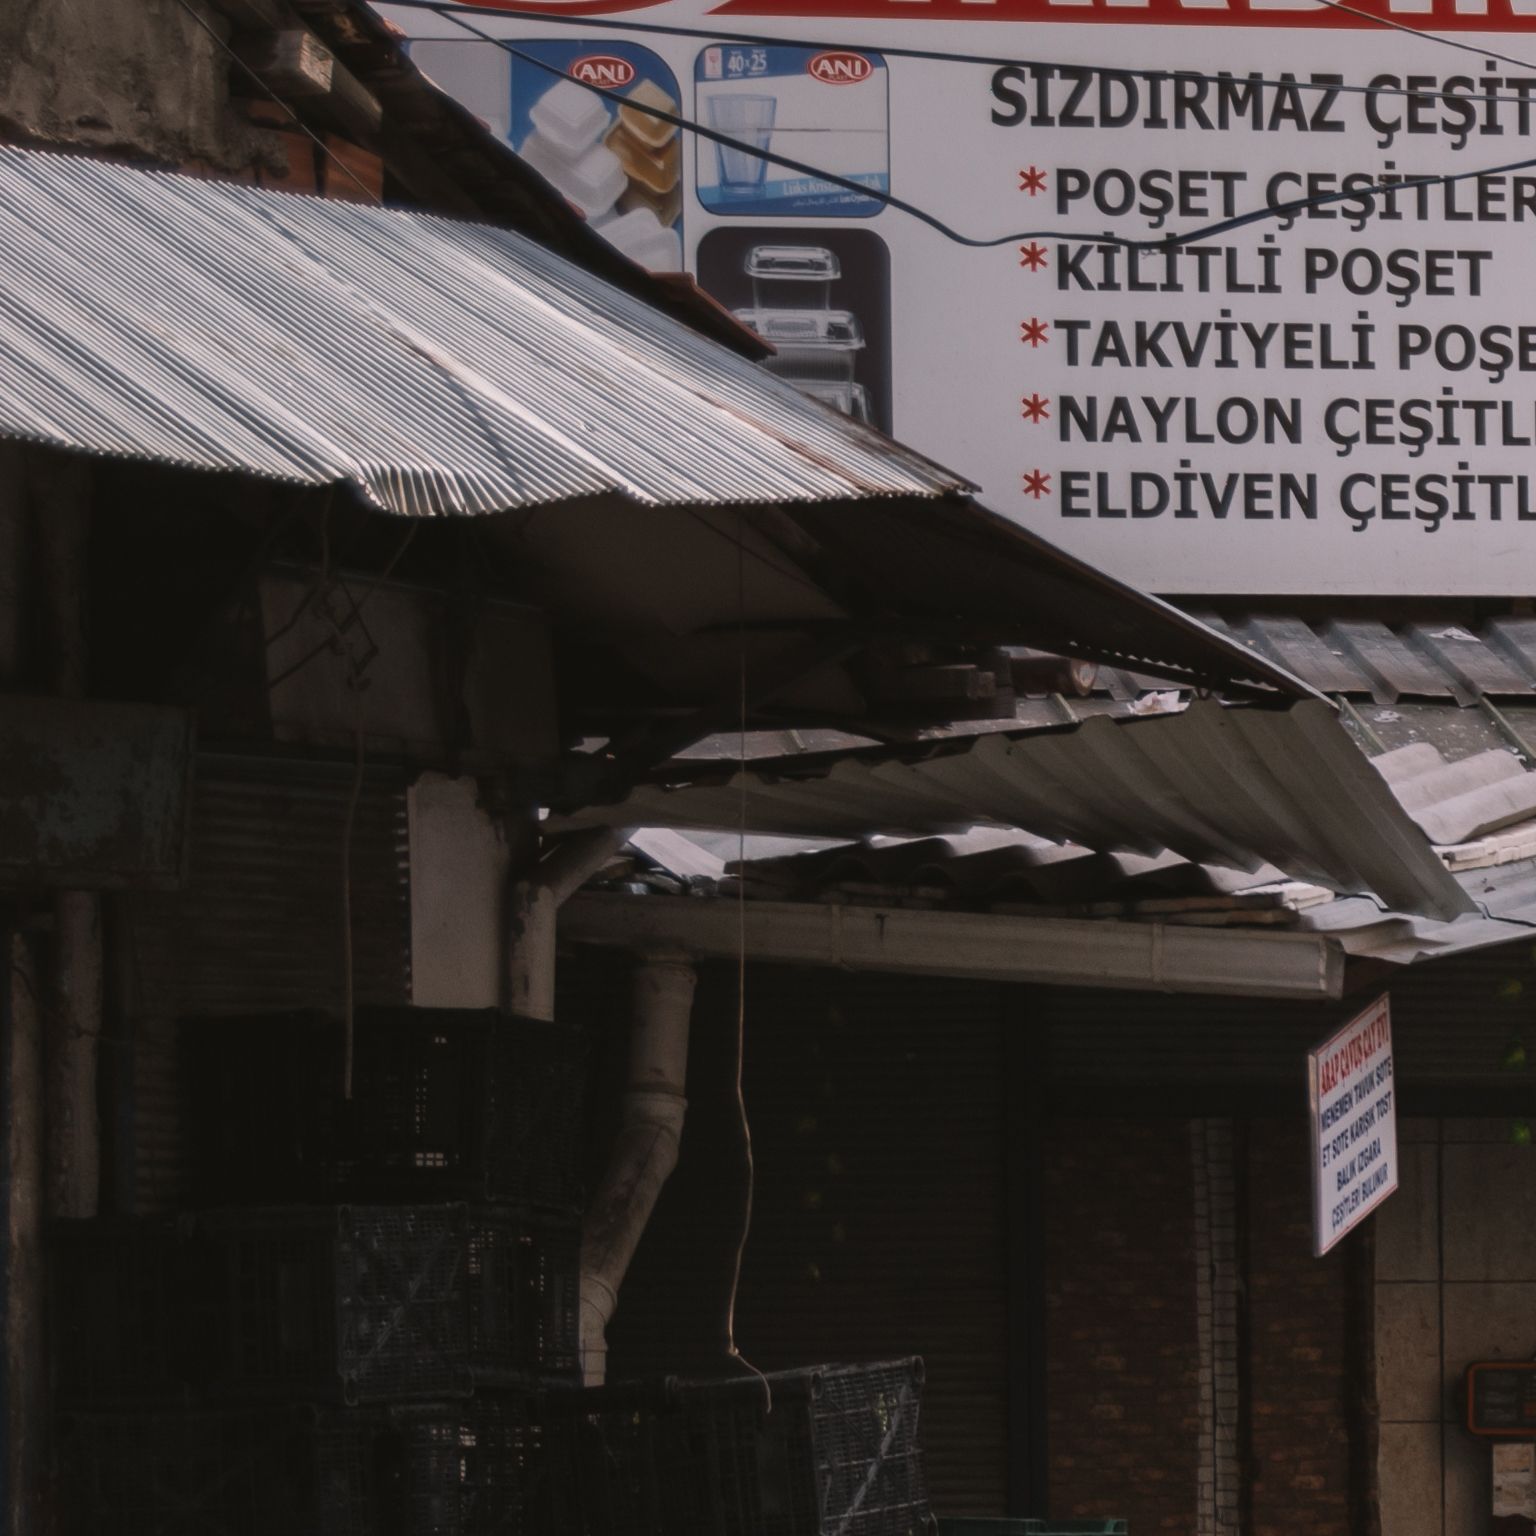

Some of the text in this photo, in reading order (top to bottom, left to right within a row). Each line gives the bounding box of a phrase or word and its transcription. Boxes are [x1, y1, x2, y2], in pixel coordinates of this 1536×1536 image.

[580, 64, 625, 83] ANI
[818, 59, 862, 78] ANI
[991, 65, 1346, 132] SIZDIRMAZ
[1055, 169, 1248, 228] POŞET
[1056, 232, 1493, 307] KİLİTLİ POŞET
[1054, 308, 1375, 370] TAKVİYELİ
[1058, 395, 1302, 445] NAYLON
[1059, 459, 1318, 520] ELDİVEN
[1320, 1053, 1340, 1098] ARAP
[1321, 1056, 1392, 1133] MENEMEN TAVUK SOTE
[1322, 1091, 1392, 1168] ET SOTE KARIŞIK TOST
[1337, 1137, 1382, 1192] BALIK IZGARA
[1332, 1162, 1388, 1234] ÇEŞİTLERİ BULUNUR
